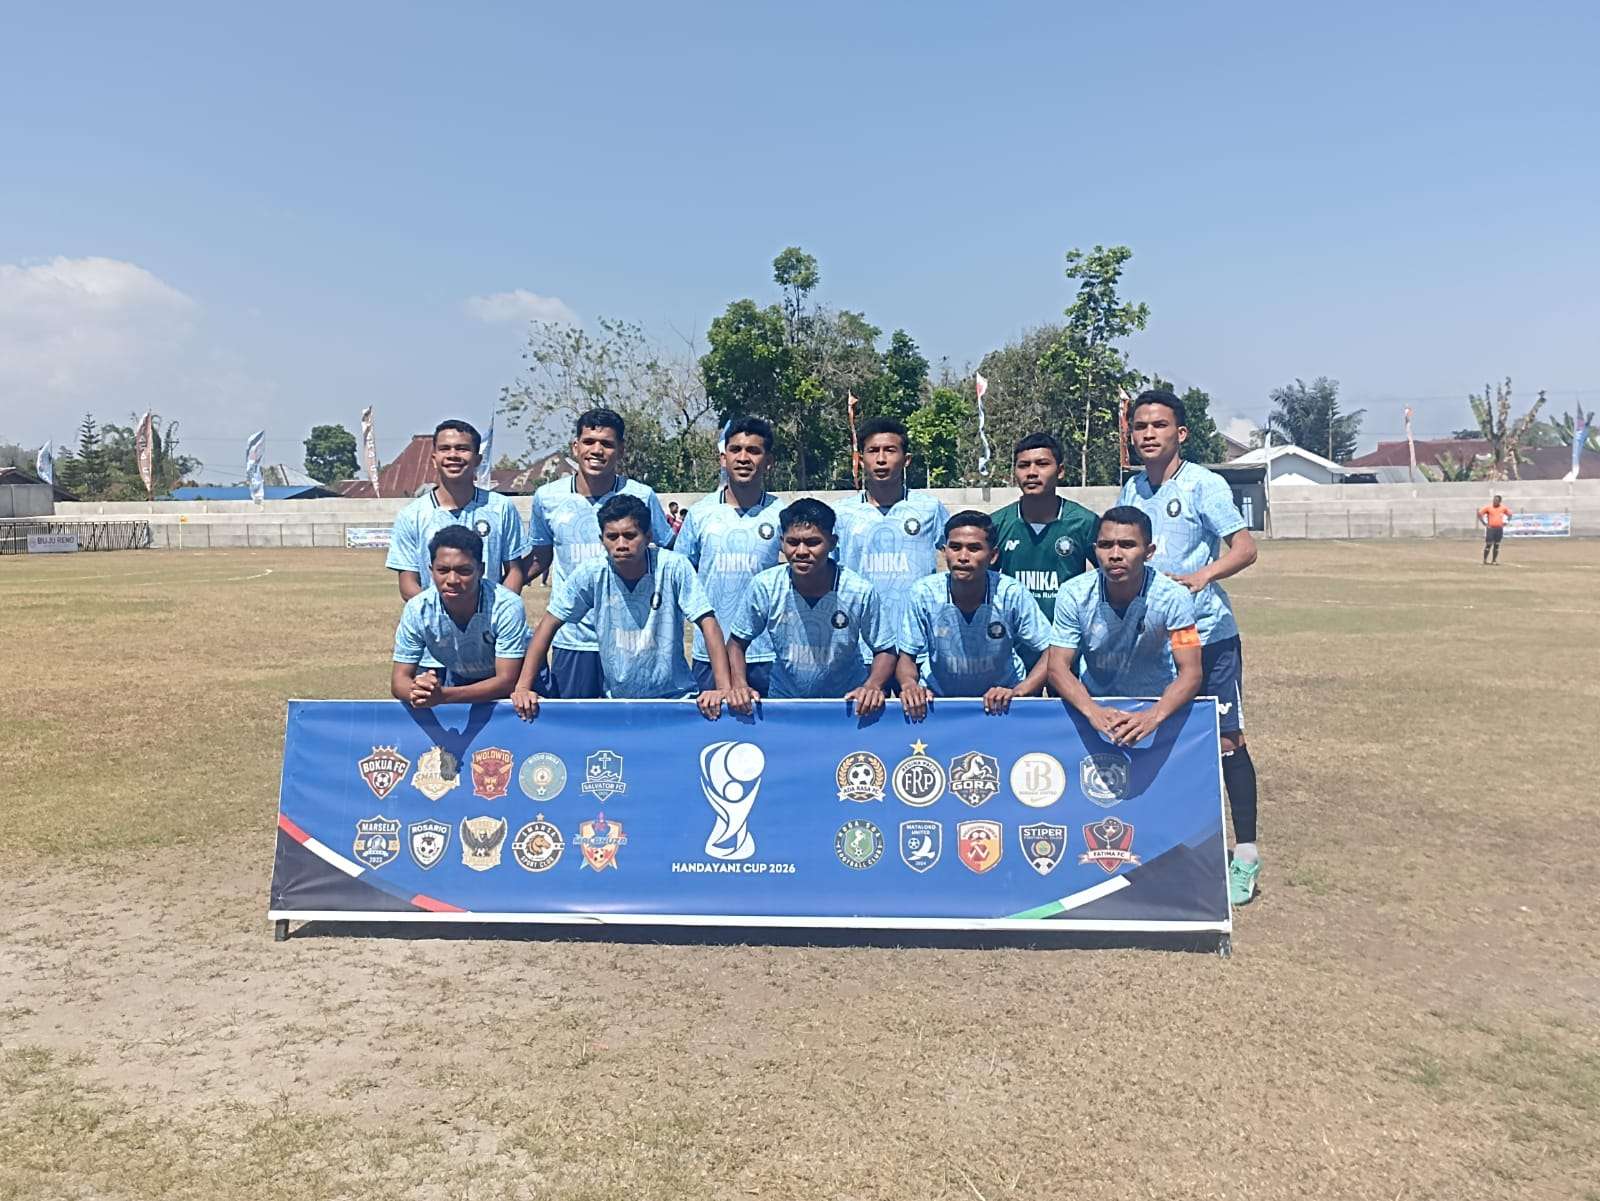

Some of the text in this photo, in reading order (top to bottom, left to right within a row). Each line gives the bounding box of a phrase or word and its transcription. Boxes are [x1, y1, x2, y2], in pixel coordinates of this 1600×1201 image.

[862, 552, 910, 572] UNIKA
[1015, 570, 1059, 591] UNIKA
[362, 761, 407, 774] BOKUA FC
[952, 780, 997, 791] GORA
[361, 823, 396, 832] MARSELA
[411, 823, 447, 834] ROSARIO
[1023, 828, 1062, 837] STIPER
[671, 862, 796, 873] HANDAYANI CUP 2026
